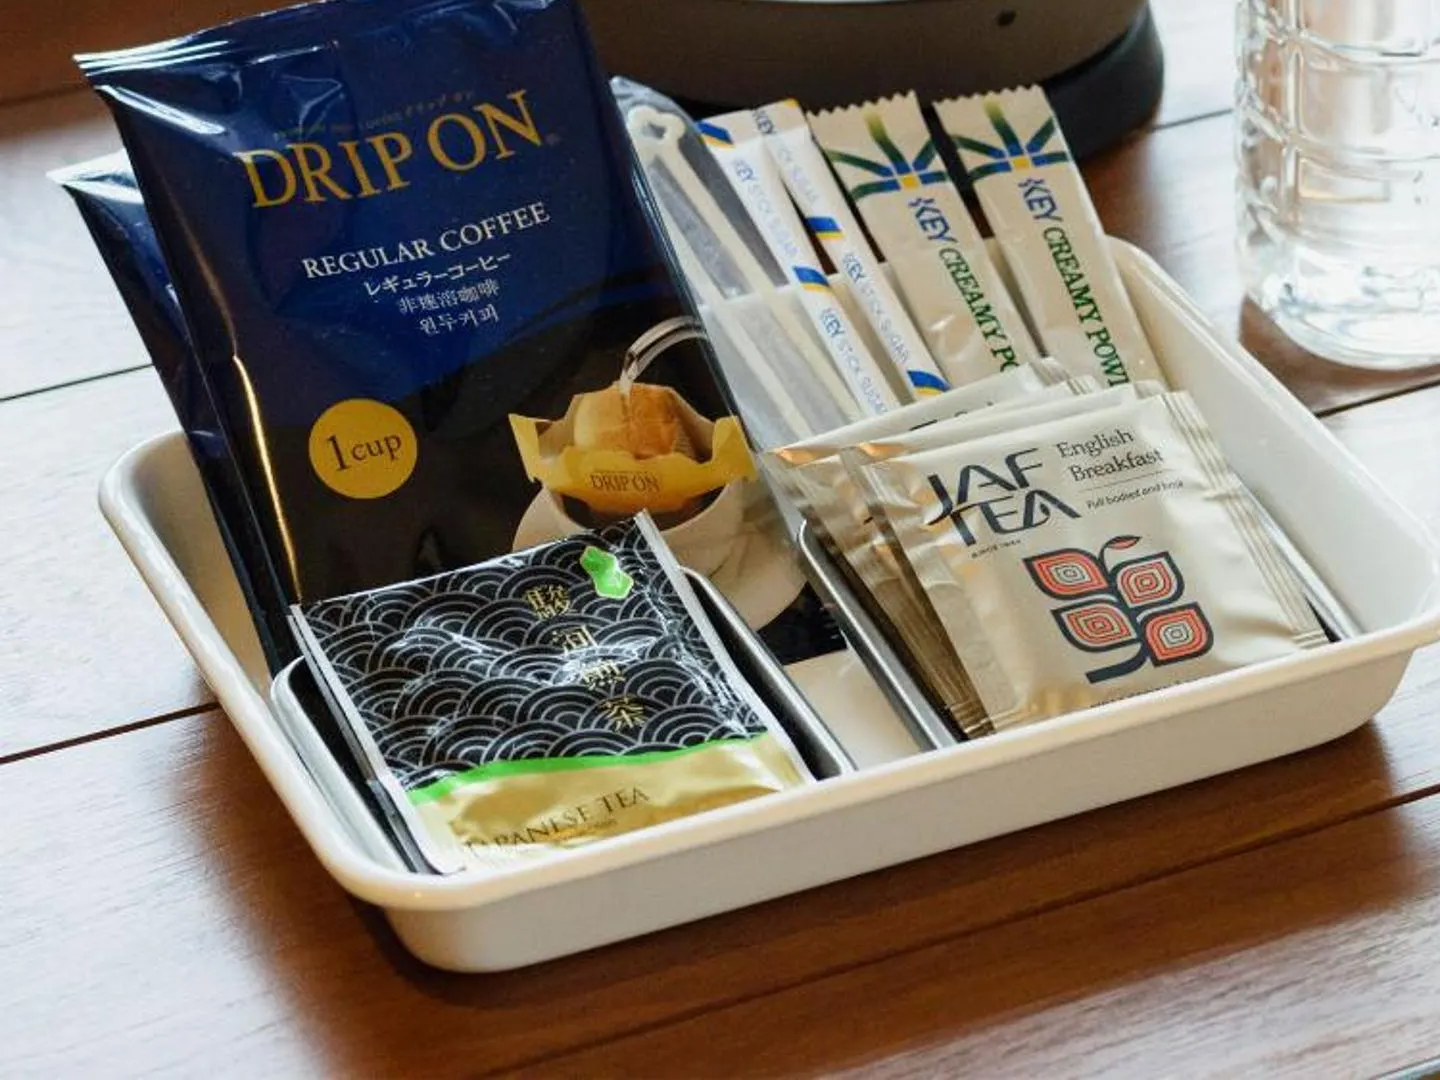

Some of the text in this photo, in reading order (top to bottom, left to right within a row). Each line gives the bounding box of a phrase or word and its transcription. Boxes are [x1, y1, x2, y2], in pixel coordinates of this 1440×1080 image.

[232, 132, 413, 208] DRIP
[427, 89, 542, 171] ON
[302, 202, 551, 278] REGULAR COFFEE
[908, 197, 957, 243] KEY
[939, 247, 1008, 342] CREAMY
[1018, 178, 1063, 222] KEY
[1043, 227, 1103, 324] CREAMY
[364, 253, 511, 296] レギュラーコーヒー
[326, 434, 402, 471] 1 cup
[1056, 428, 1134, 458] English
[1068, 449, 1165, 483] Breakfast
[591, 471, 660, 493] DRIP ON
[925, 447, 1042, 526] JAF
[950, 489, 1082, 547] TEA
[463, 804, 593, 848] PANESE
[596, 787, 649, 814] TEA
